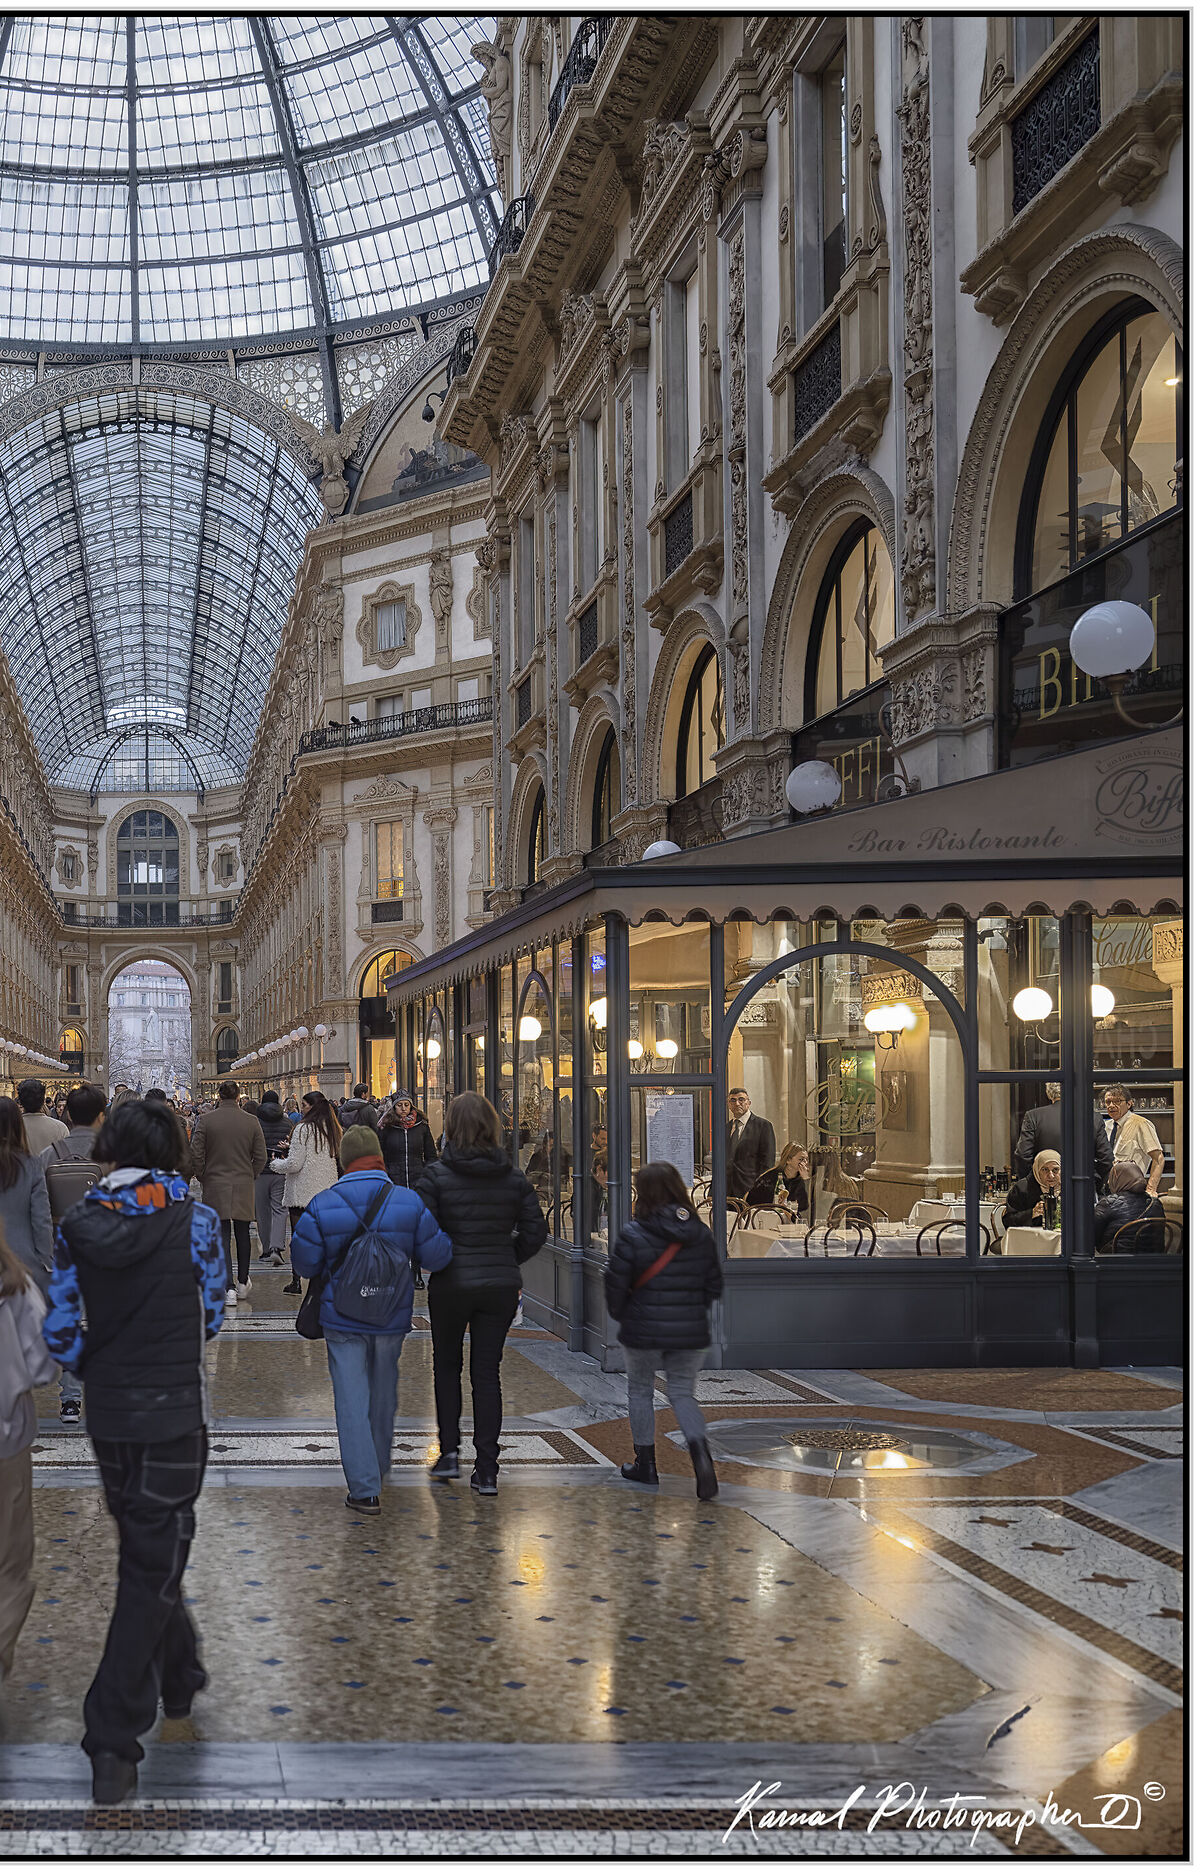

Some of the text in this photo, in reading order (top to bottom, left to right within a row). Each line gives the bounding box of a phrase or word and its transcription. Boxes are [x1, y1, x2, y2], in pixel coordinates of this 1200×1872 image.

[1038, 594, 1161, 721] BII
[848, 826, 1068, 852] Bar Ristorante
